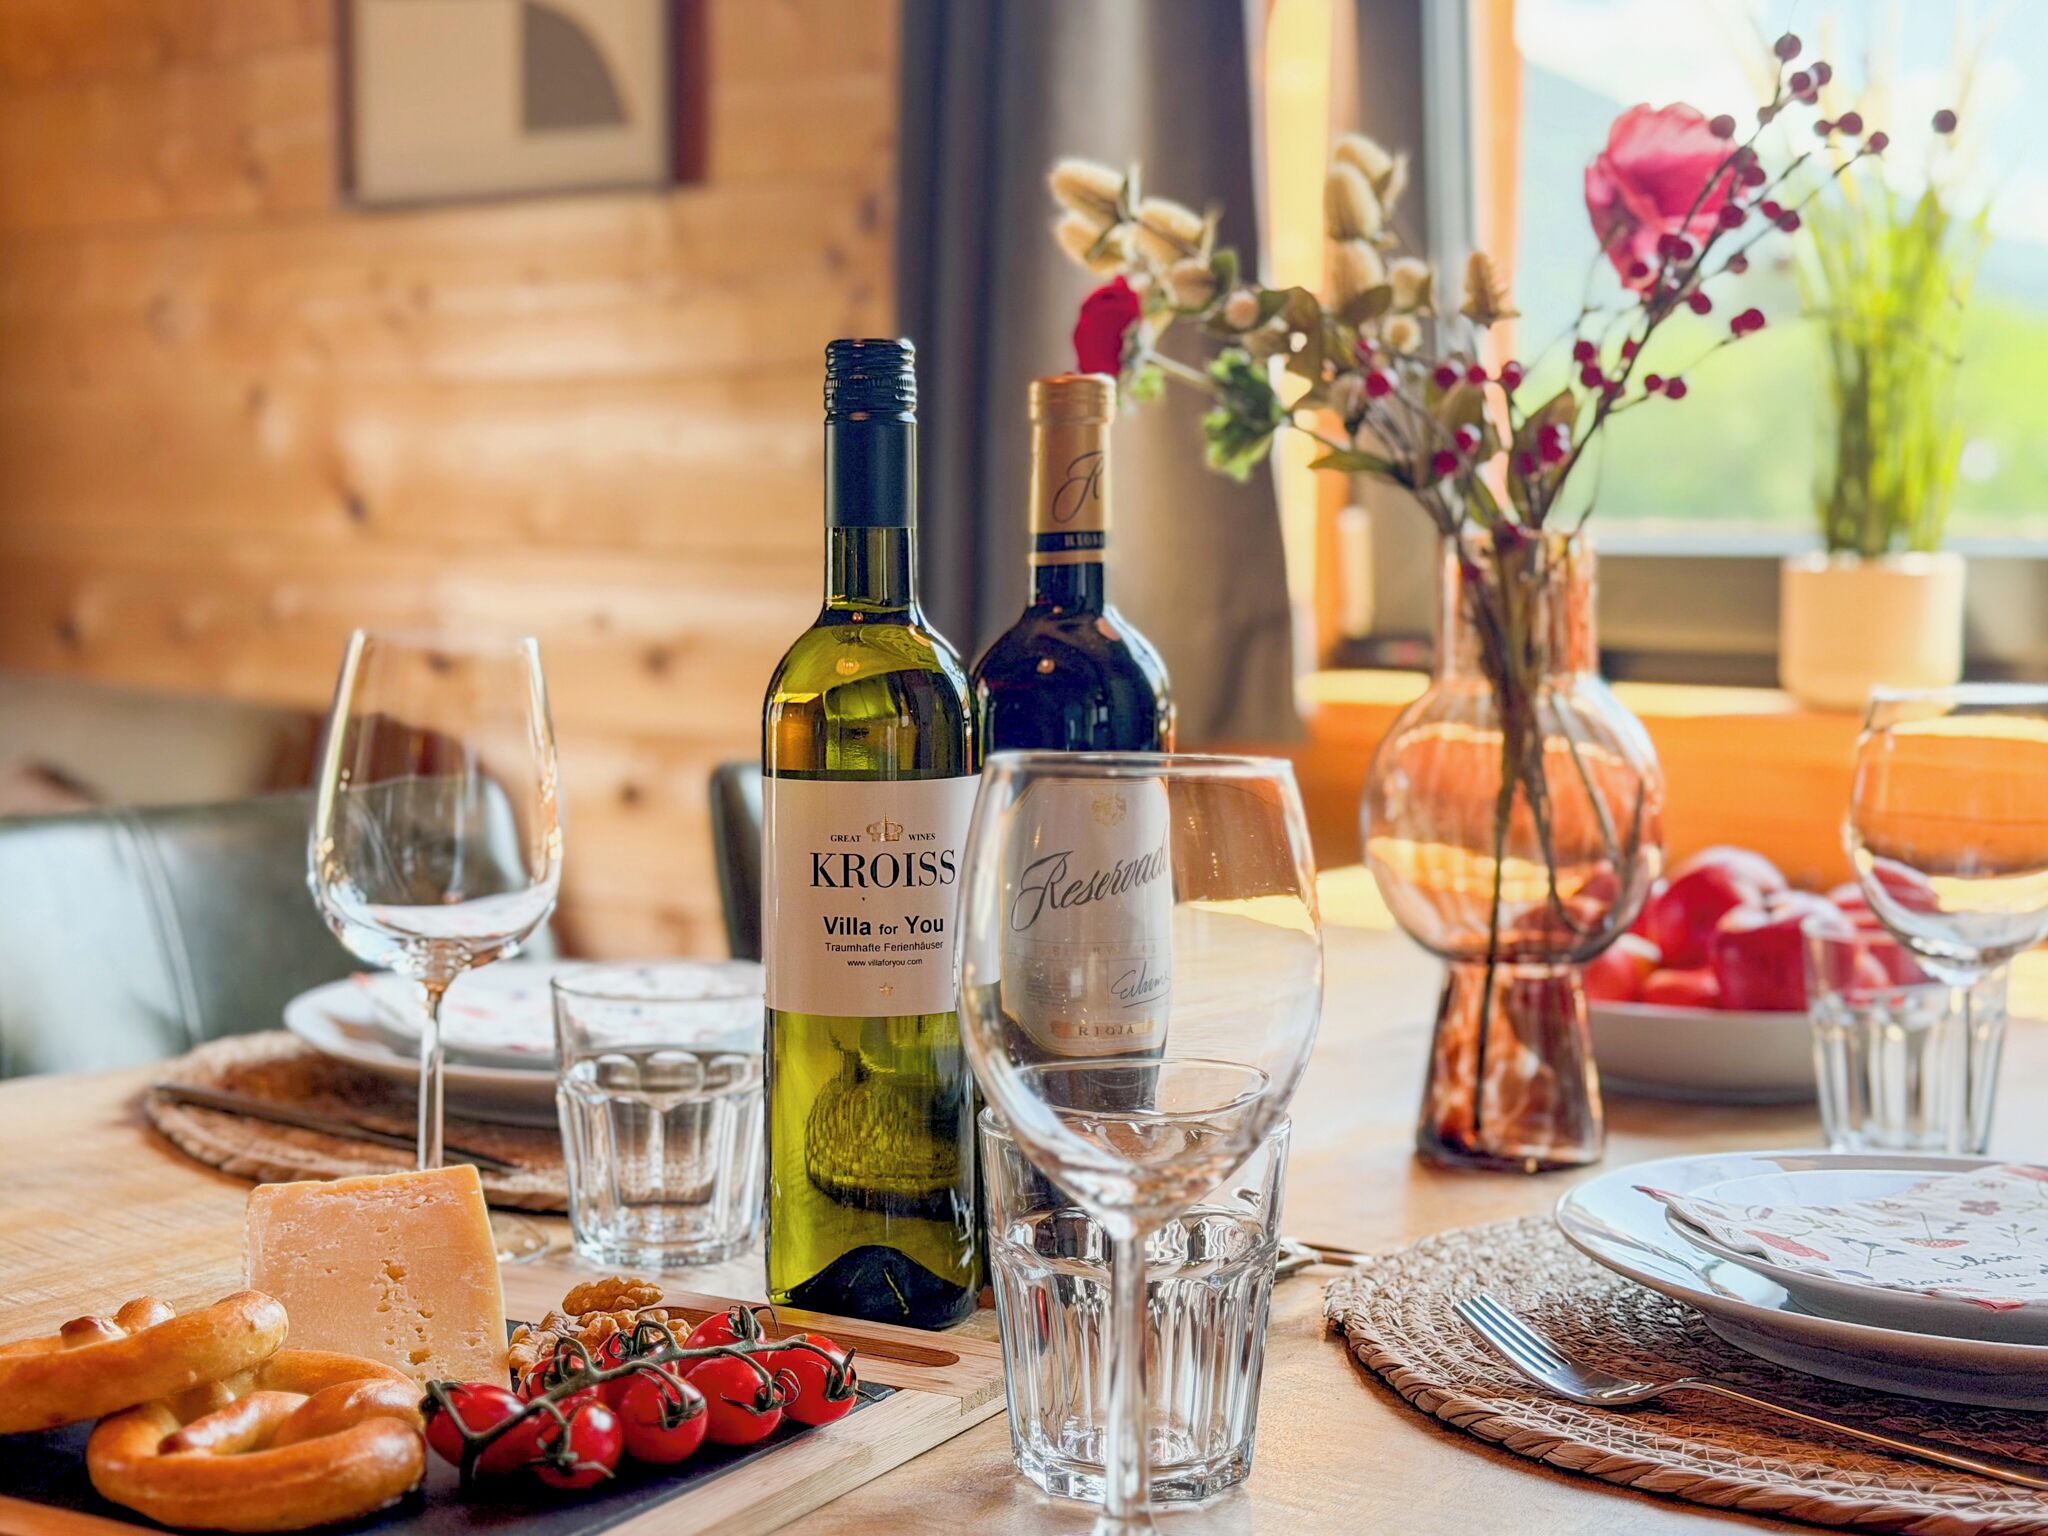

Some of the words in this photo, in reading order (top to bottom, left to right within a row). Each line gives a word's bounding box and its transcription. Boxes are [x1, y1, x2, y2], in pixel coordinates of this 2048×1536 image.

[830, 834, 862, 843] GREAT
[908, 832, 936, 841] WINES
[809, 849, 957, 889] KROISS
[823, 916, 872, 936] Villa
[879, 923, 899, 935] for
[905, 915, 944, 934] You
[825, 942, 881, 952] Traumhafte
[884, 940, 944, 952] Ferienhäuser
[847, 956, 923, 967] www.villaforyou.com
[1078, 1024, 1135, 1037] RIOJA
